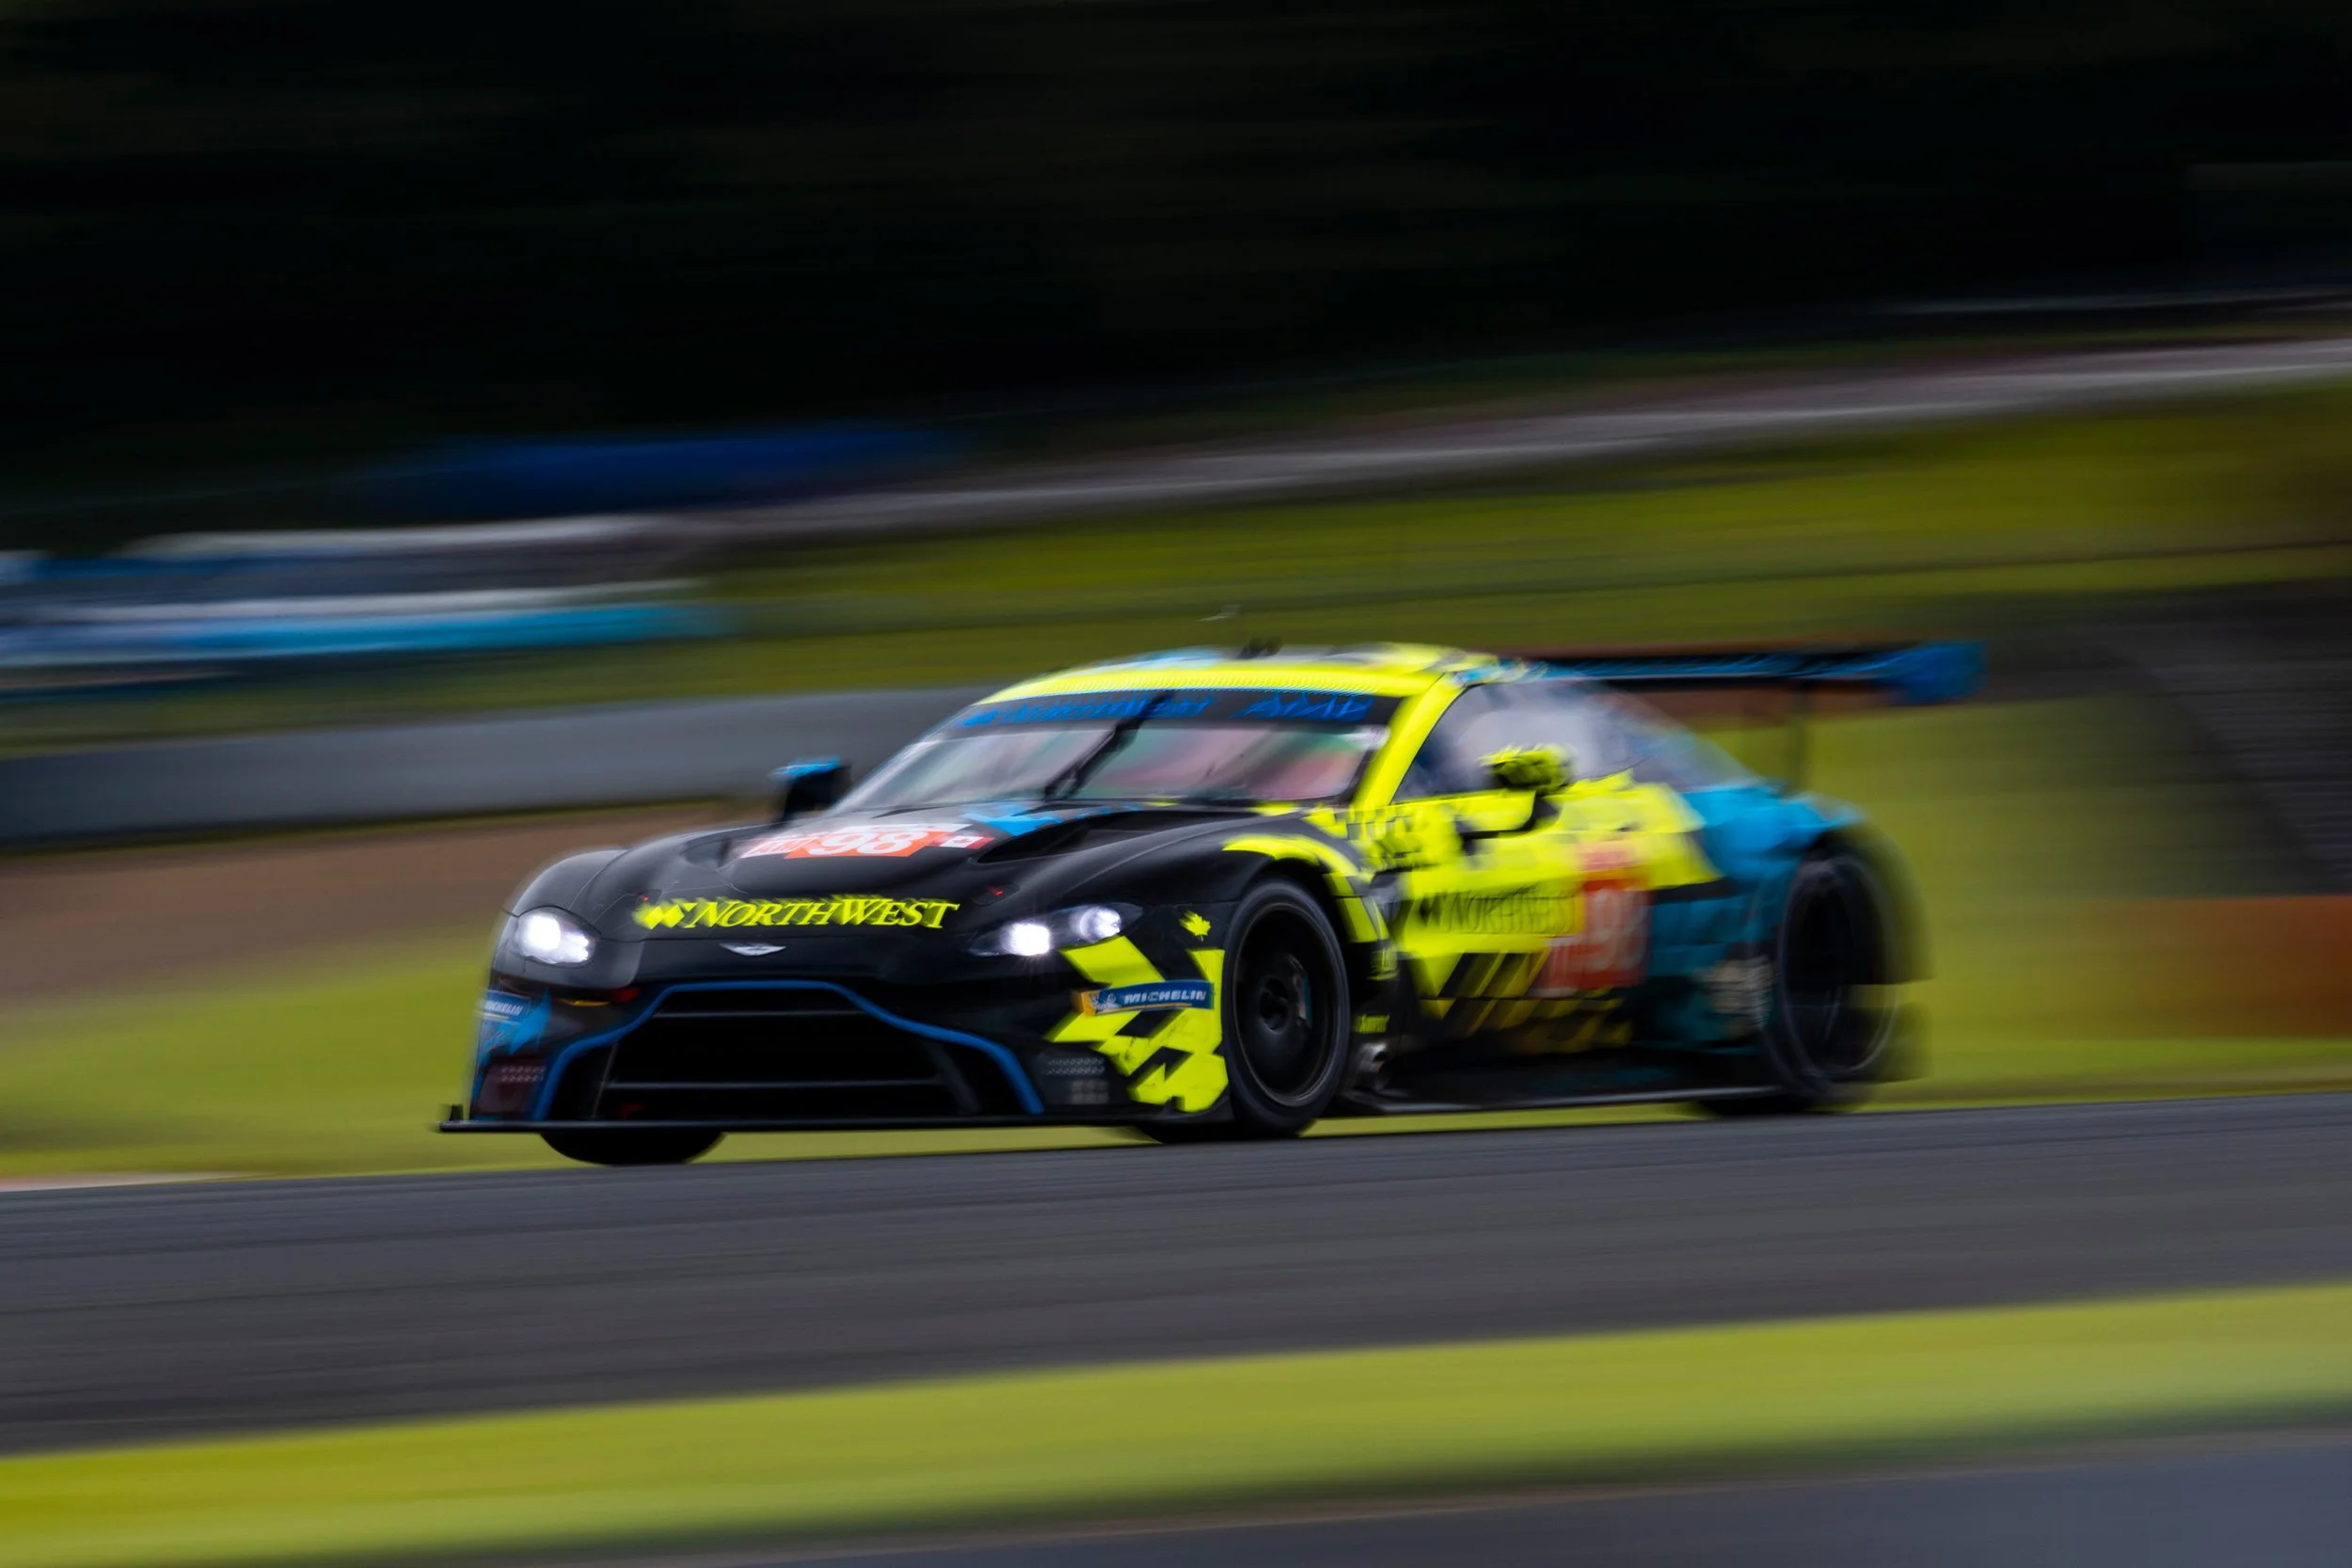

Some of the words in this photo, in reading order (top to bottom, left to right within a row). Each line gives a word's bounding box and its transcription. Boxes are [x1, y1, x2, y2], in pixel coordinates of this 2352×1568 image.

[808, 831, 929, 855] 98
[684, 896, 960, 928] NORTHWEST
[1123, 990, 1207, 1005] MICHELIN
